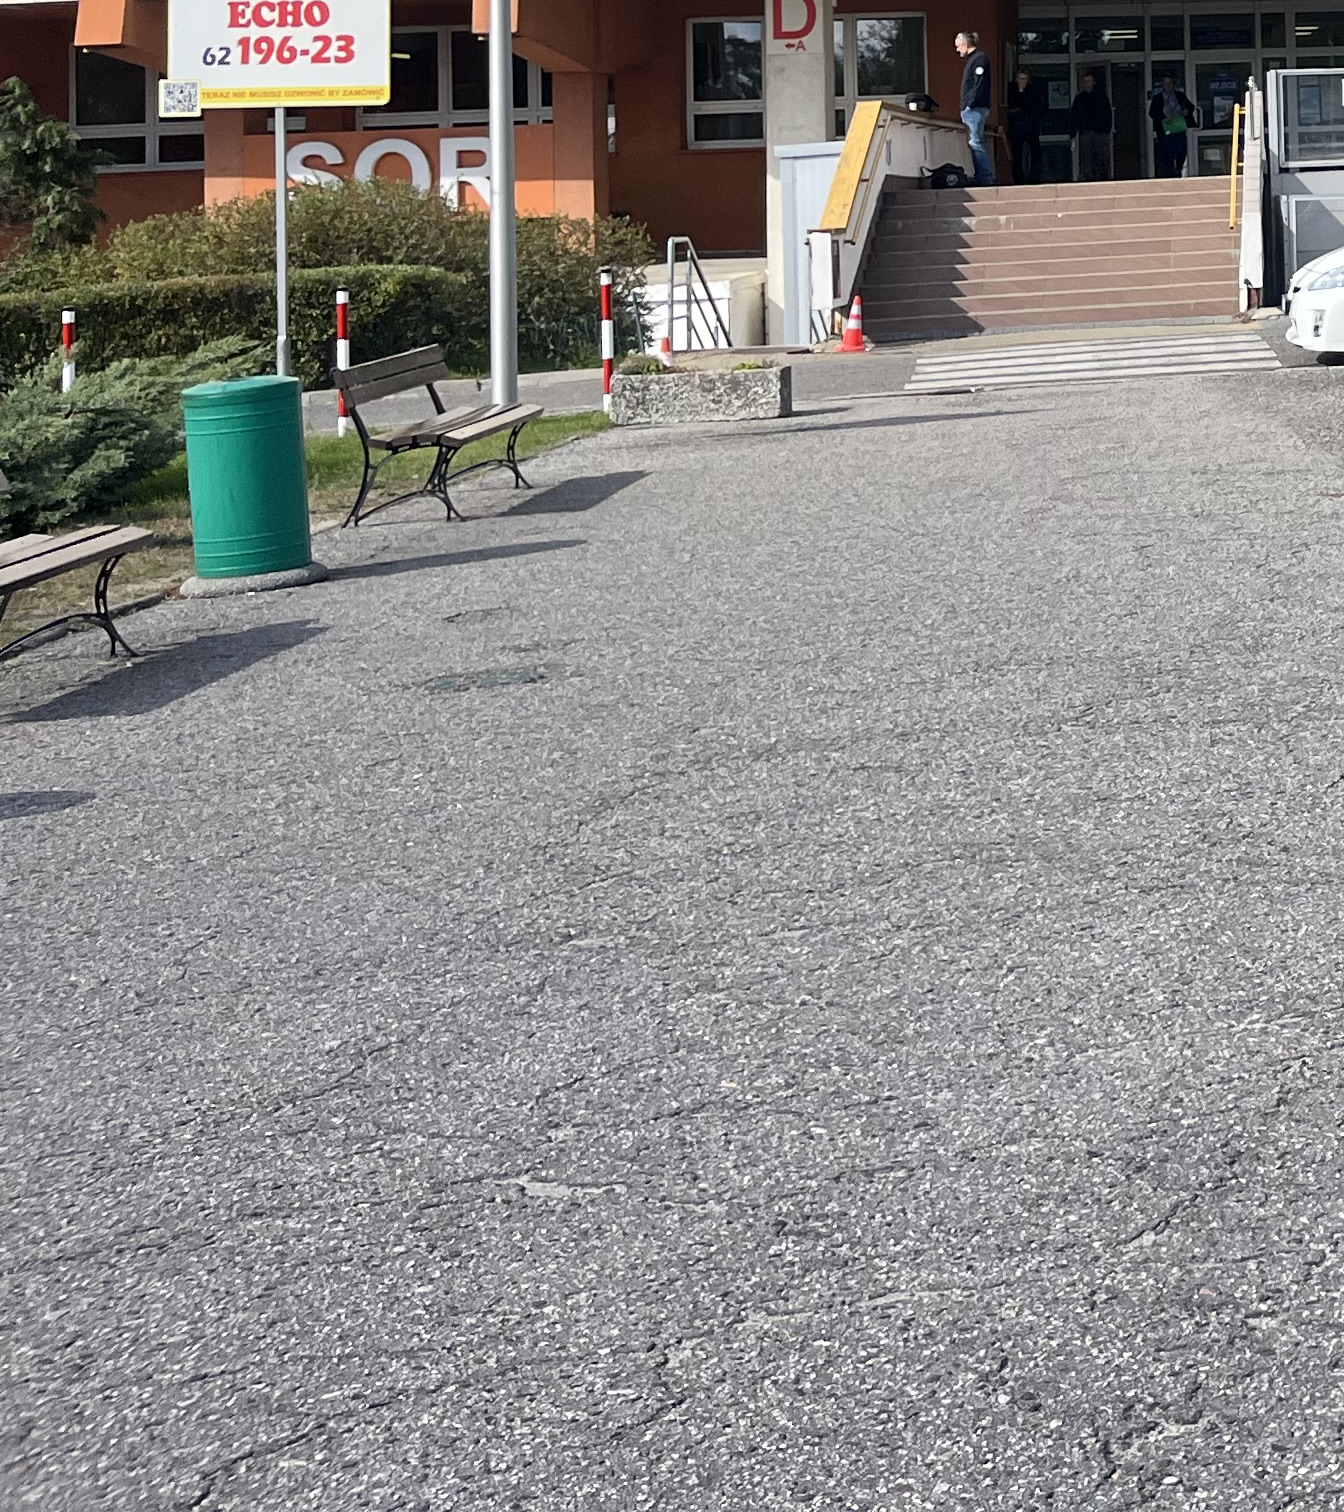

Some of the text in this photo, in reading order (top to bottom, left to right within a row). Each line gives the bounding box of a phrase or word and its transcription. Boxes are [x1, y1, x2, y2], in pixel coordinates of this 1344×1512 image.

[227, 0, 330, 28] ECHO
[202, 34, 355, 66] 62 196-23
[795, 39, 807, 52] A
[202, 86, 384, 100] TERAZ NIE MUSISZ DZWONIĆ BY ZAMÓWIĆ
[286, 137, 491, 211] SOR
